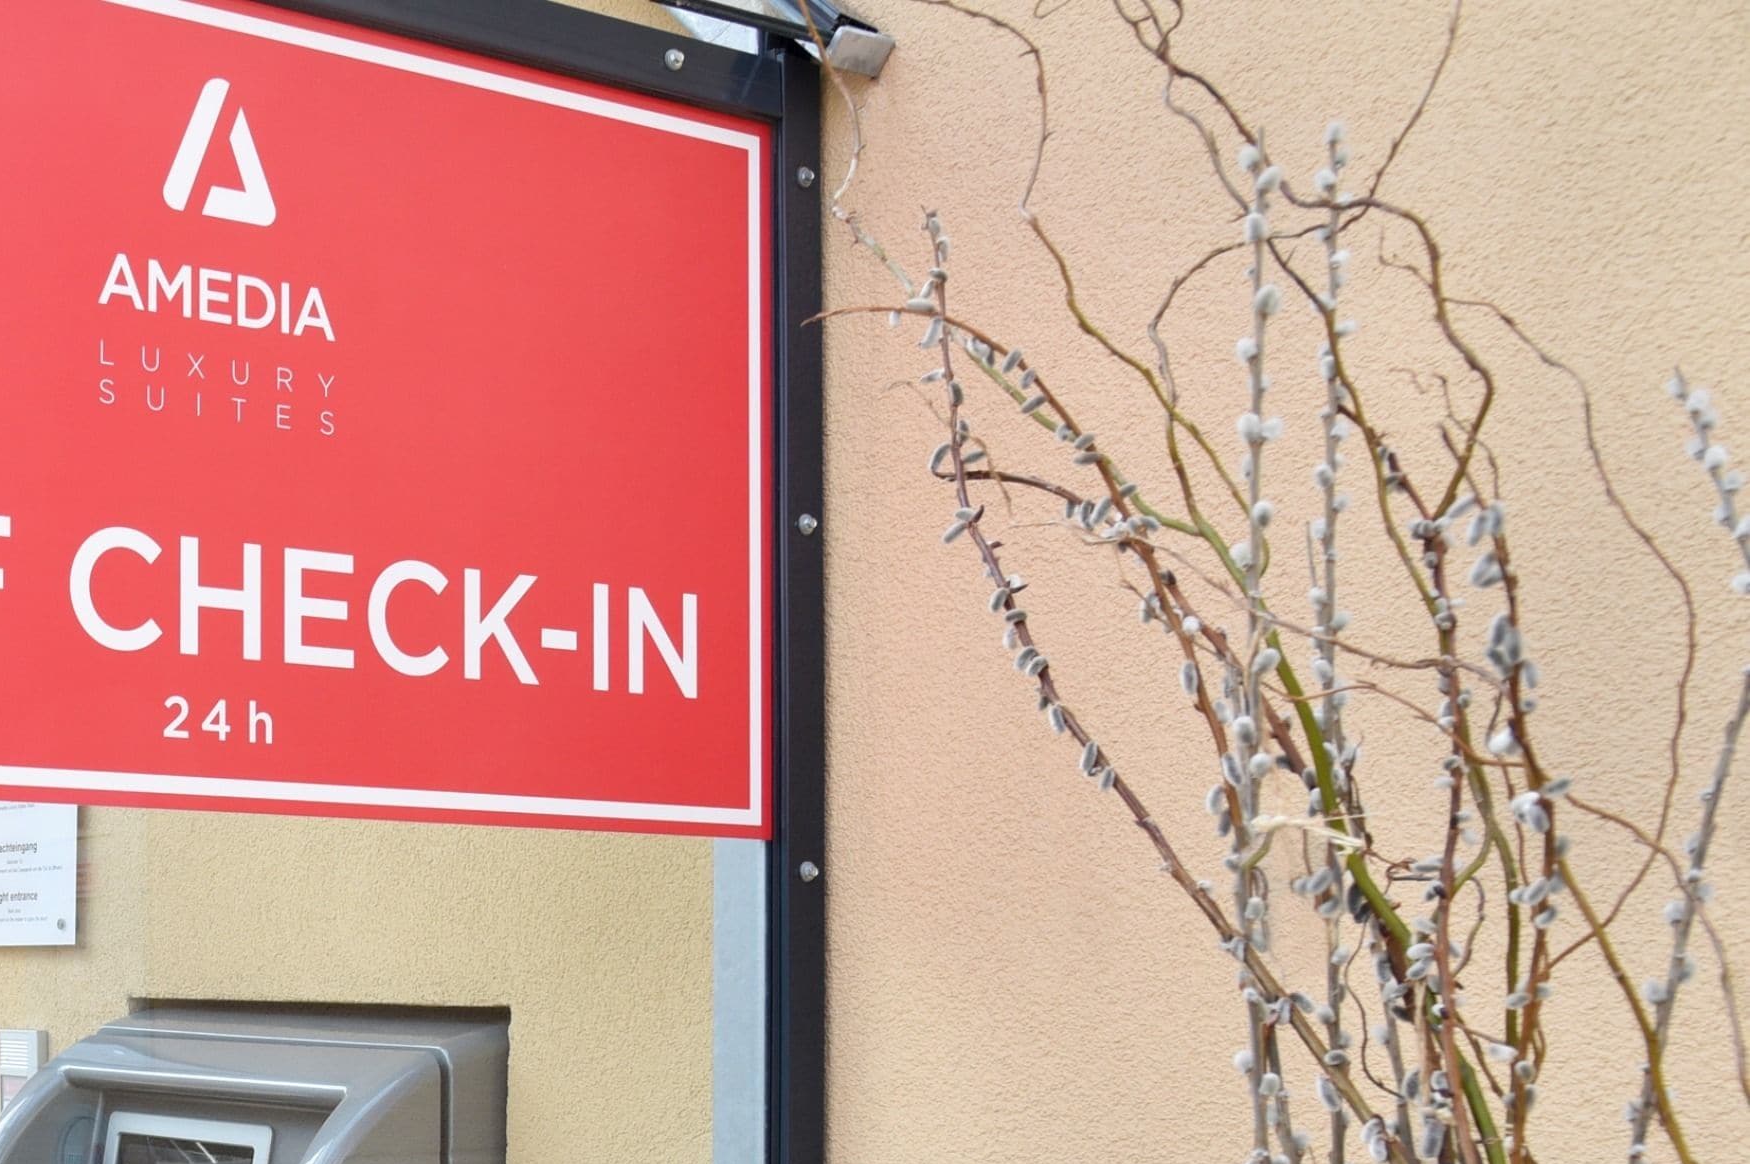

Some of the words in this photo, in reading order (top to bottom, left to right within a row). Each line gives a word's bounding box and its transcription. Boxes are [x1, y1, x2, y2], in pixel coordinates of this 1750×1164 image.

[98, 253, 336, 342] AMEDIA
[98, 338, 336, 399] LUXURY
[98, 378, 336, 437] SUITES
[69, 526, 699, 700] CHECK-IN
[10, 891, 38, 901] entrance
